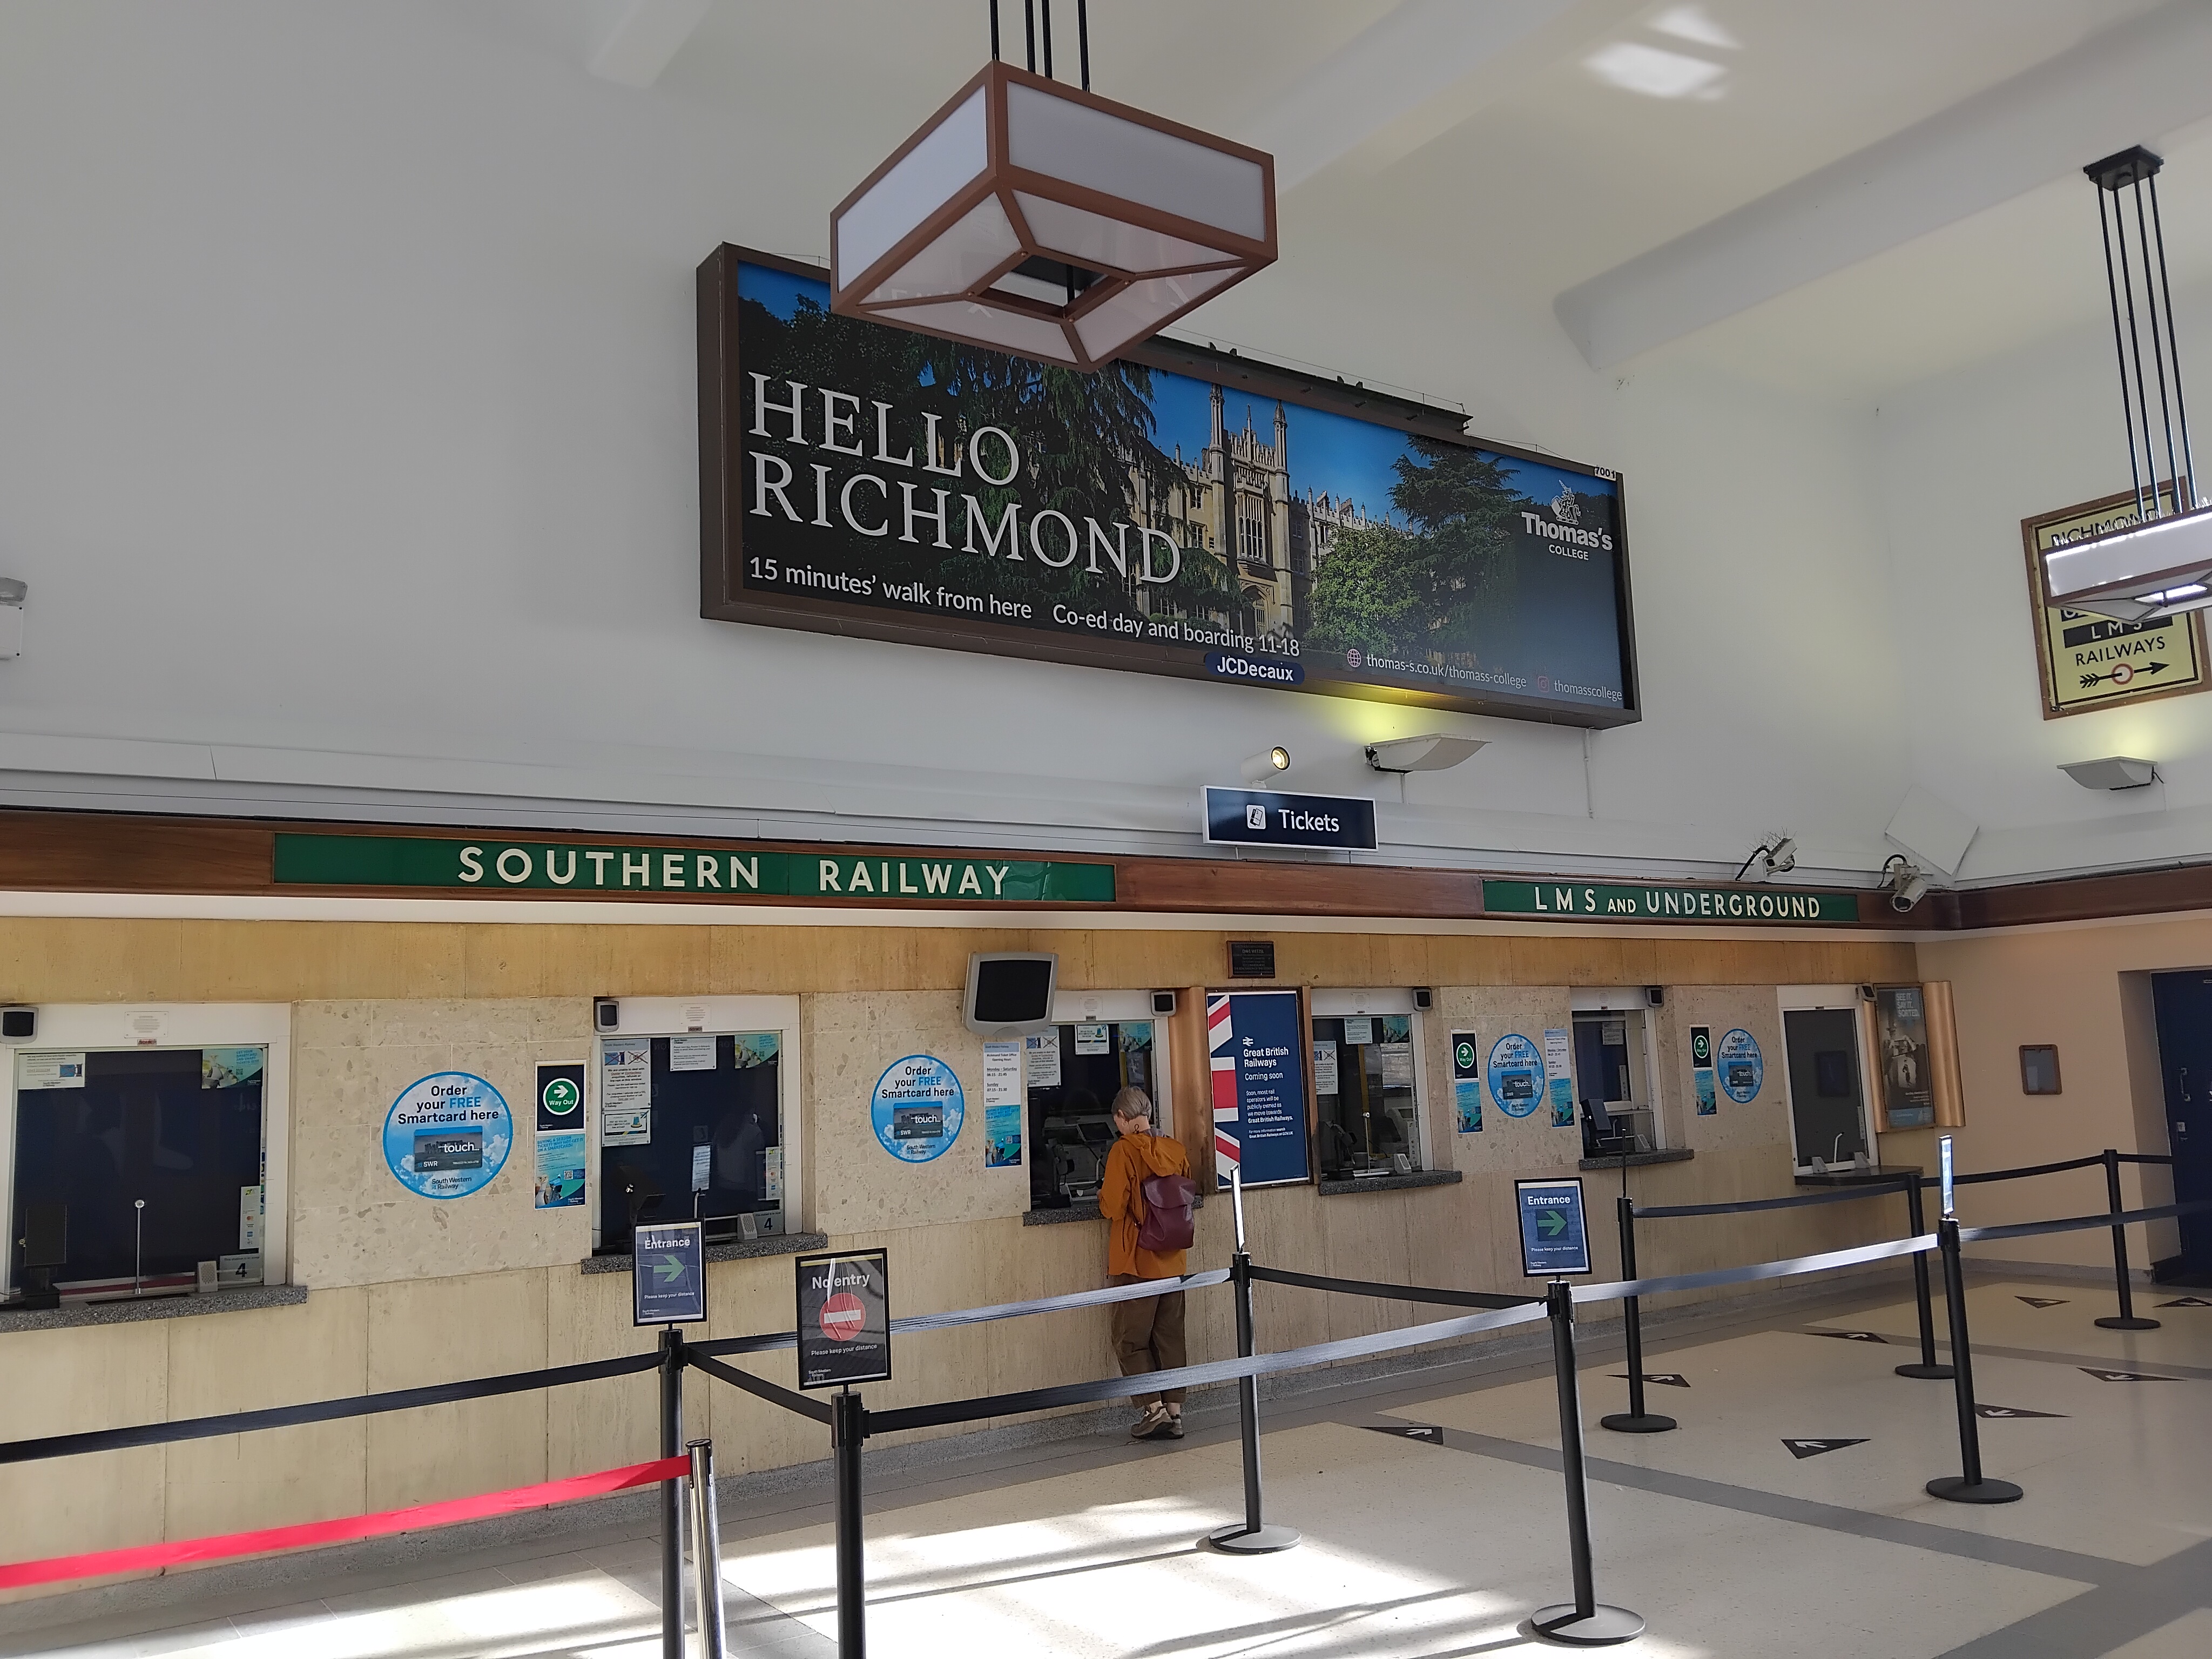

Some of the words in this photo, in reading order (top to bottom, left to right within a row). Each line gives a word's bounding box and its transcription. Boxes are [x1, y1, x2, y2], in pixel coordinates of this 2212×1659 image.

[748, 372, 1020, 485] HELLO
[1595, 467, 1615, 478] 7001
[748, 450, 1182, 584] RICHMOND
[1521, 511, 1613, 550] Thomas's
[1549, 544, 1589, 561] COLLEGE
[750, 557, 777, 579] 15
[882, 582, 931, 605] walk
[936, 587, 983, 611] from
[990, 594, 1032, 619] here
[1053, 604, 1107, 630] Co-ed
[1113, 612, 1143, 638] day
[1148, 621, 1178, 640] and
[1184, 622, 1254, 653] boarding
[1259, 635, 1299, 657] 11-18
[2075, 636, 2165, 666] RAILWAYS
[1217, 655, 1294, 682] JCDecaux
[1366, 654, 1527, 688] thomas-s.co.uk/thomass-college
[1554, 679, 1622, 701] thomasscollege
[1278, 809, 1339, 832] Tickets
[457, 846, 759, 889] SOUTHERN
[820, 860, 1009, 895] RAILWAY
[1607, 897, 1637, 914] AND
[1646, 891, 1820, 918] UNDERGROUND
[1243, 1048, 1264, 1057] Great
[1265, 1047, 1289, 1056] British
[1501, 1053, 1513, 1061] your
[1244, 1058, 1277, 1068] Railways
[1493, 1060, 1523, 1068] Smartcard
[905, 1066, 931, 1075] Order
[1245, 1072, 1267, 1081] Coming
[895, 1080, 916, 1089] your
[919, 1076, 941, 1086] FREE
[431, 1085, 467, 1096] Order
[882, 1088, 931, 1098] Smartcard
[934, 1087, 954, 1096] here
[416, 1101, 445, 1113] your
[449, 1096, 481, 1108] FREE
[398, 1110, 467, 1124] Smartcard
[470, 1110, 499, 1120] here
[1527, 1196, 1570, 1205] Entrance
[764, 1218, 773, 1230] 4
[644, 1238, 690, 1249] Entrance
[235, 1263, 247, 1278] 4
[834, 1274, 870, 1287] entry
